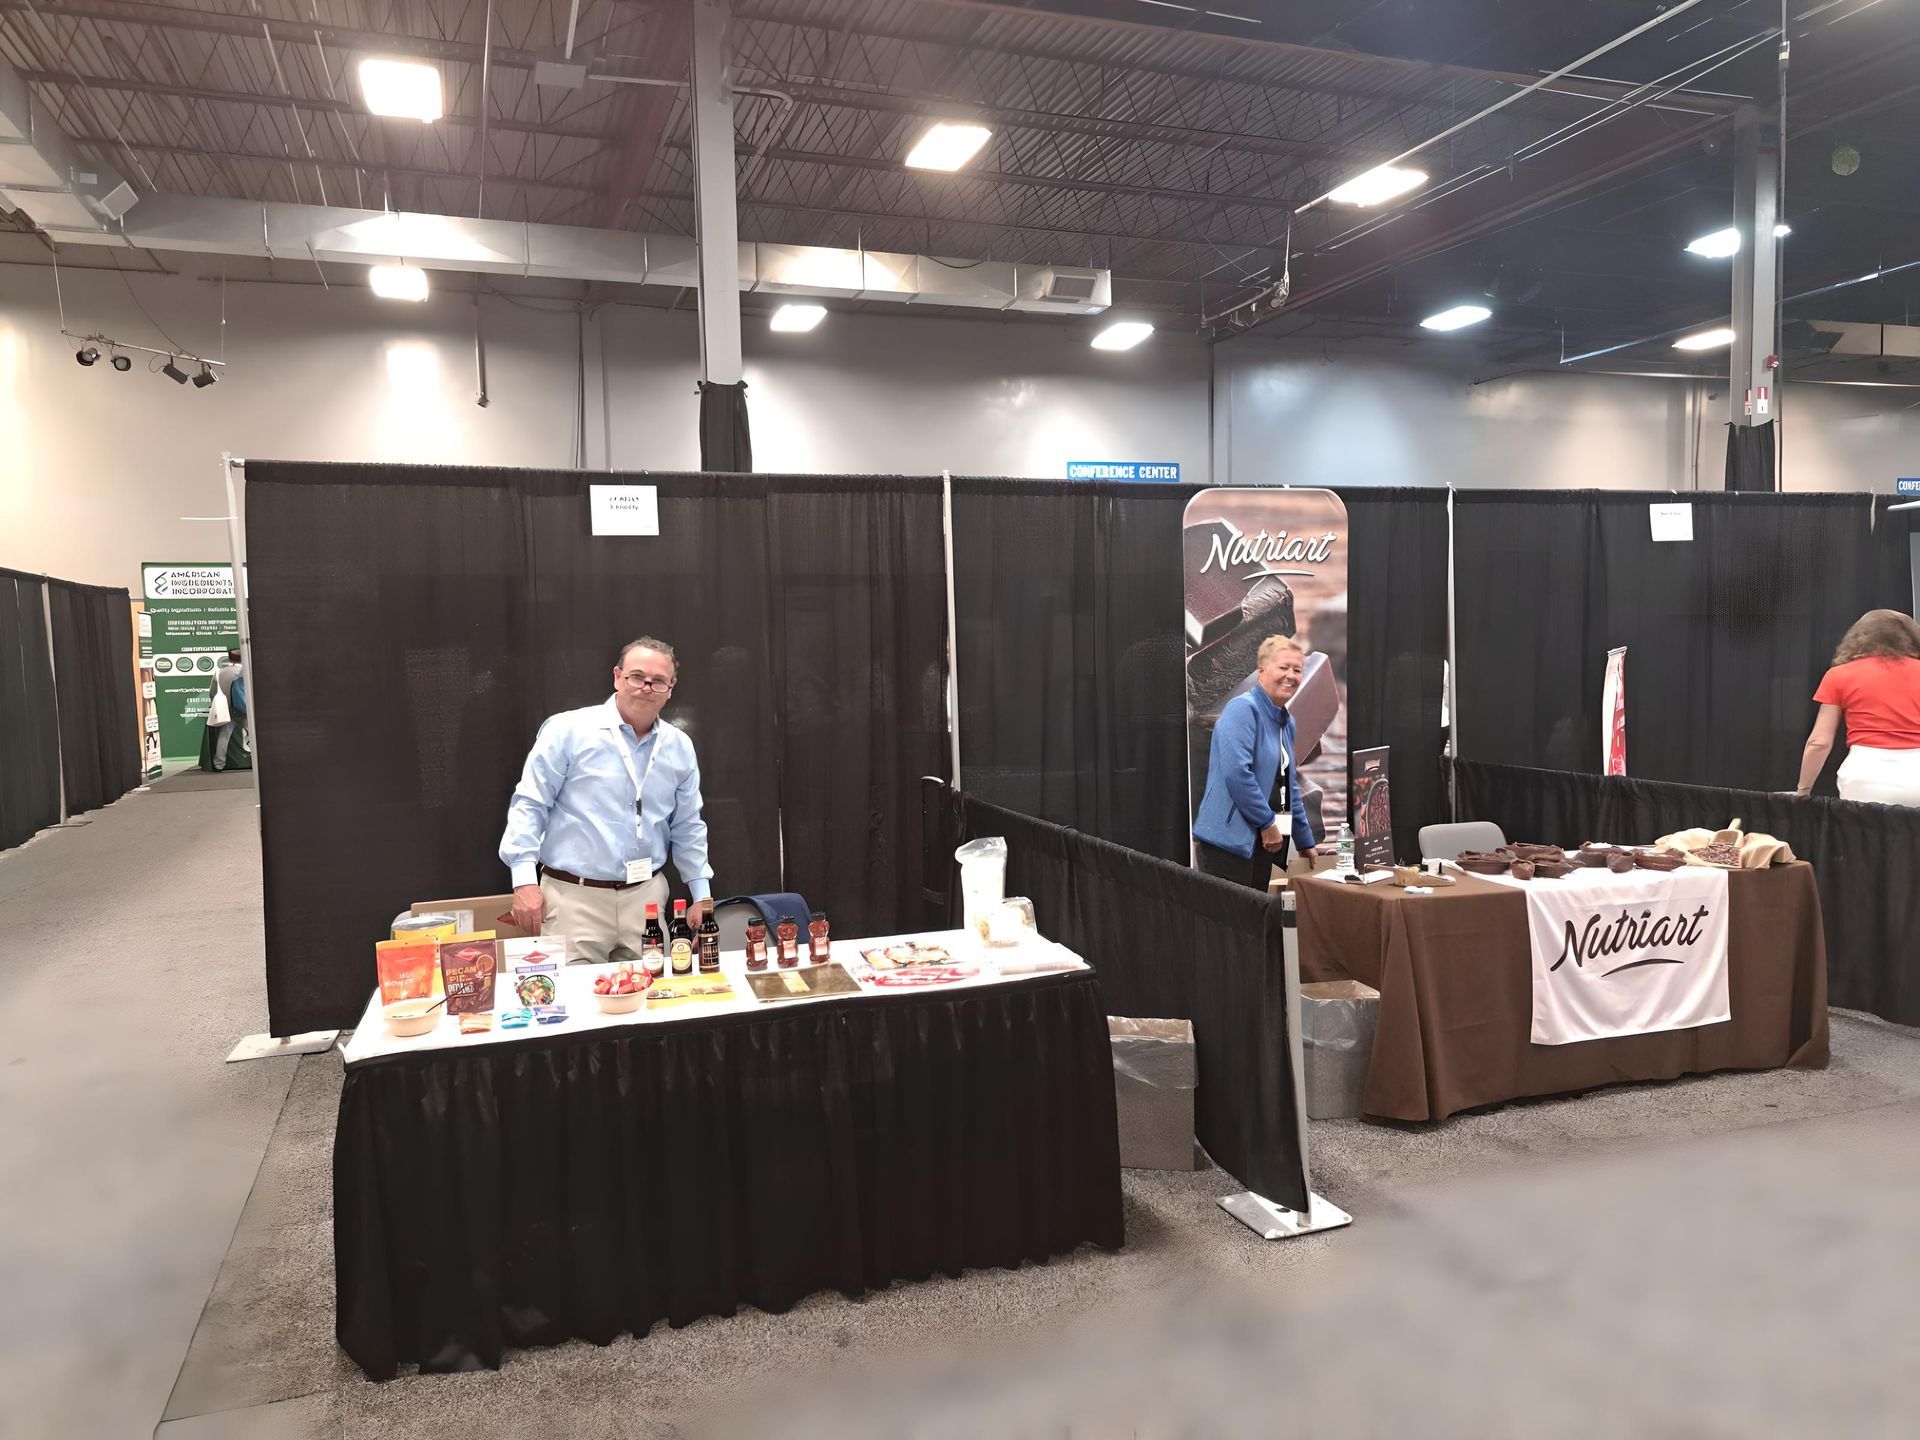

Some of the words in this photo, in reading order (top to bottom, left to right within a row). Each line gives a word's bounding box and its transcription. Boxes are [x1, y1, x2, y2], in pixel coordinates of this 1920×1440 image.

[1069, 464, 1135, 478] CONFERENCE
[1139, 466, 1177, 479] CENTER
[1200, 528, 1337, 573] Nutriart
[172, 587, 235, 595] INCORPORAT
[1550, 904, 1709, 972] Nutriart
